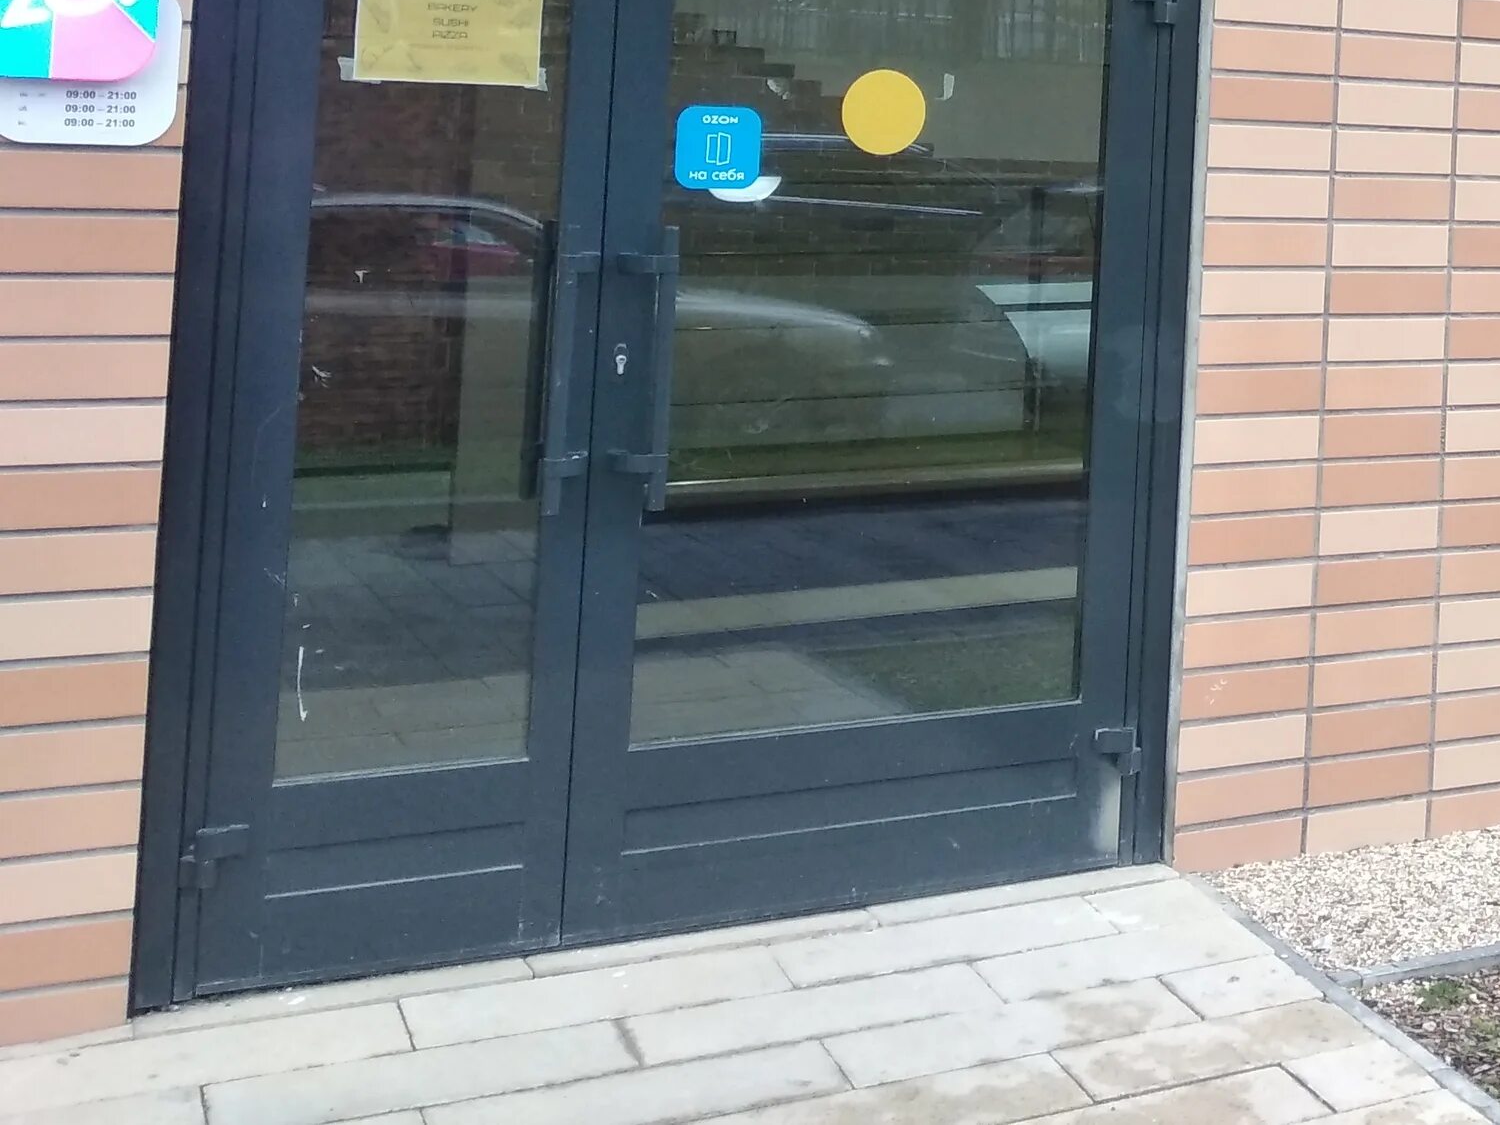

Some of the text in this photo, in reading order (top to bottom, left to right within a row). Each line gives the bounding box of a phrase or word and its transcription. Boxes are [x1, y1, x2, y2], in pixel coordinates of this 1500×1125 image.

[432, 18, 470, 28] SUSHI
[66, 90, 96, 100] 09:00
[107, 91, 137, 101] 21:00
[65, 104, 95, 114] 09:00
[106, 105, 136, 115] 21:00
[64, 118, 94, 128] 09:00
[105, 119, 135, 129] 21:00
[702, 115, 739, 125] OZON
[689, 168, 745, 181] на себя
